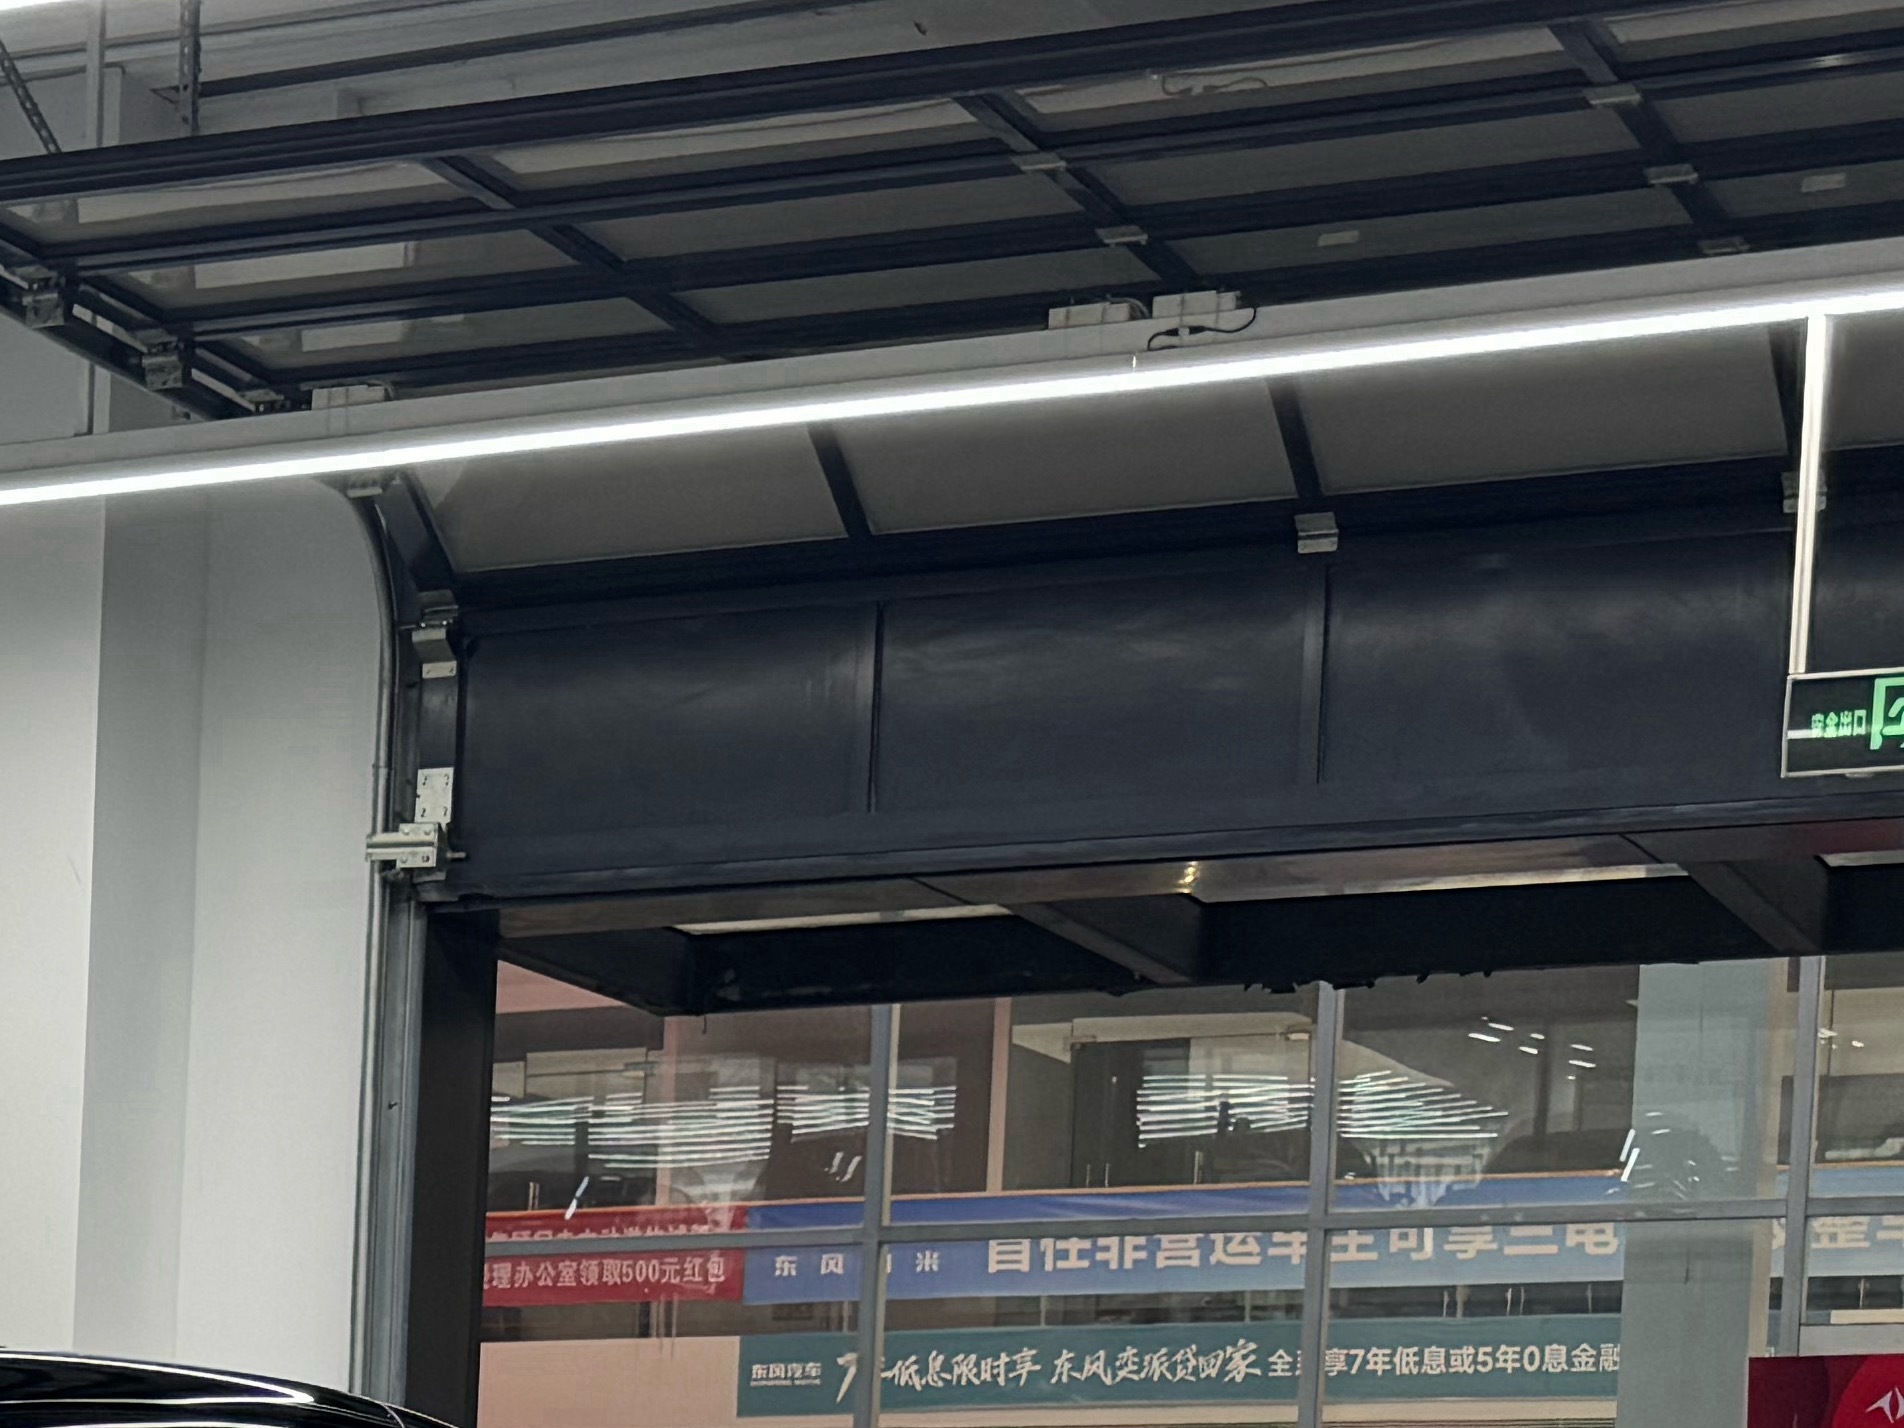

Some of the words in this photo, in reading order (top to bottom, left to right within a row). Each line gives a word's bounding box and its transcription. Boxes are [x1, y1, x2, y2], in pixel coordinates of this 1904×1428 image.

[483, 1256, 725, 1290] 理办公室领取500元红包
[774, 1250, 941, 1277] 东风米
[835, 1346, 1041, 1404] 7低息限时享
[1267, 1342, 1620, 1377] 全享7年低息或5年0息金融
